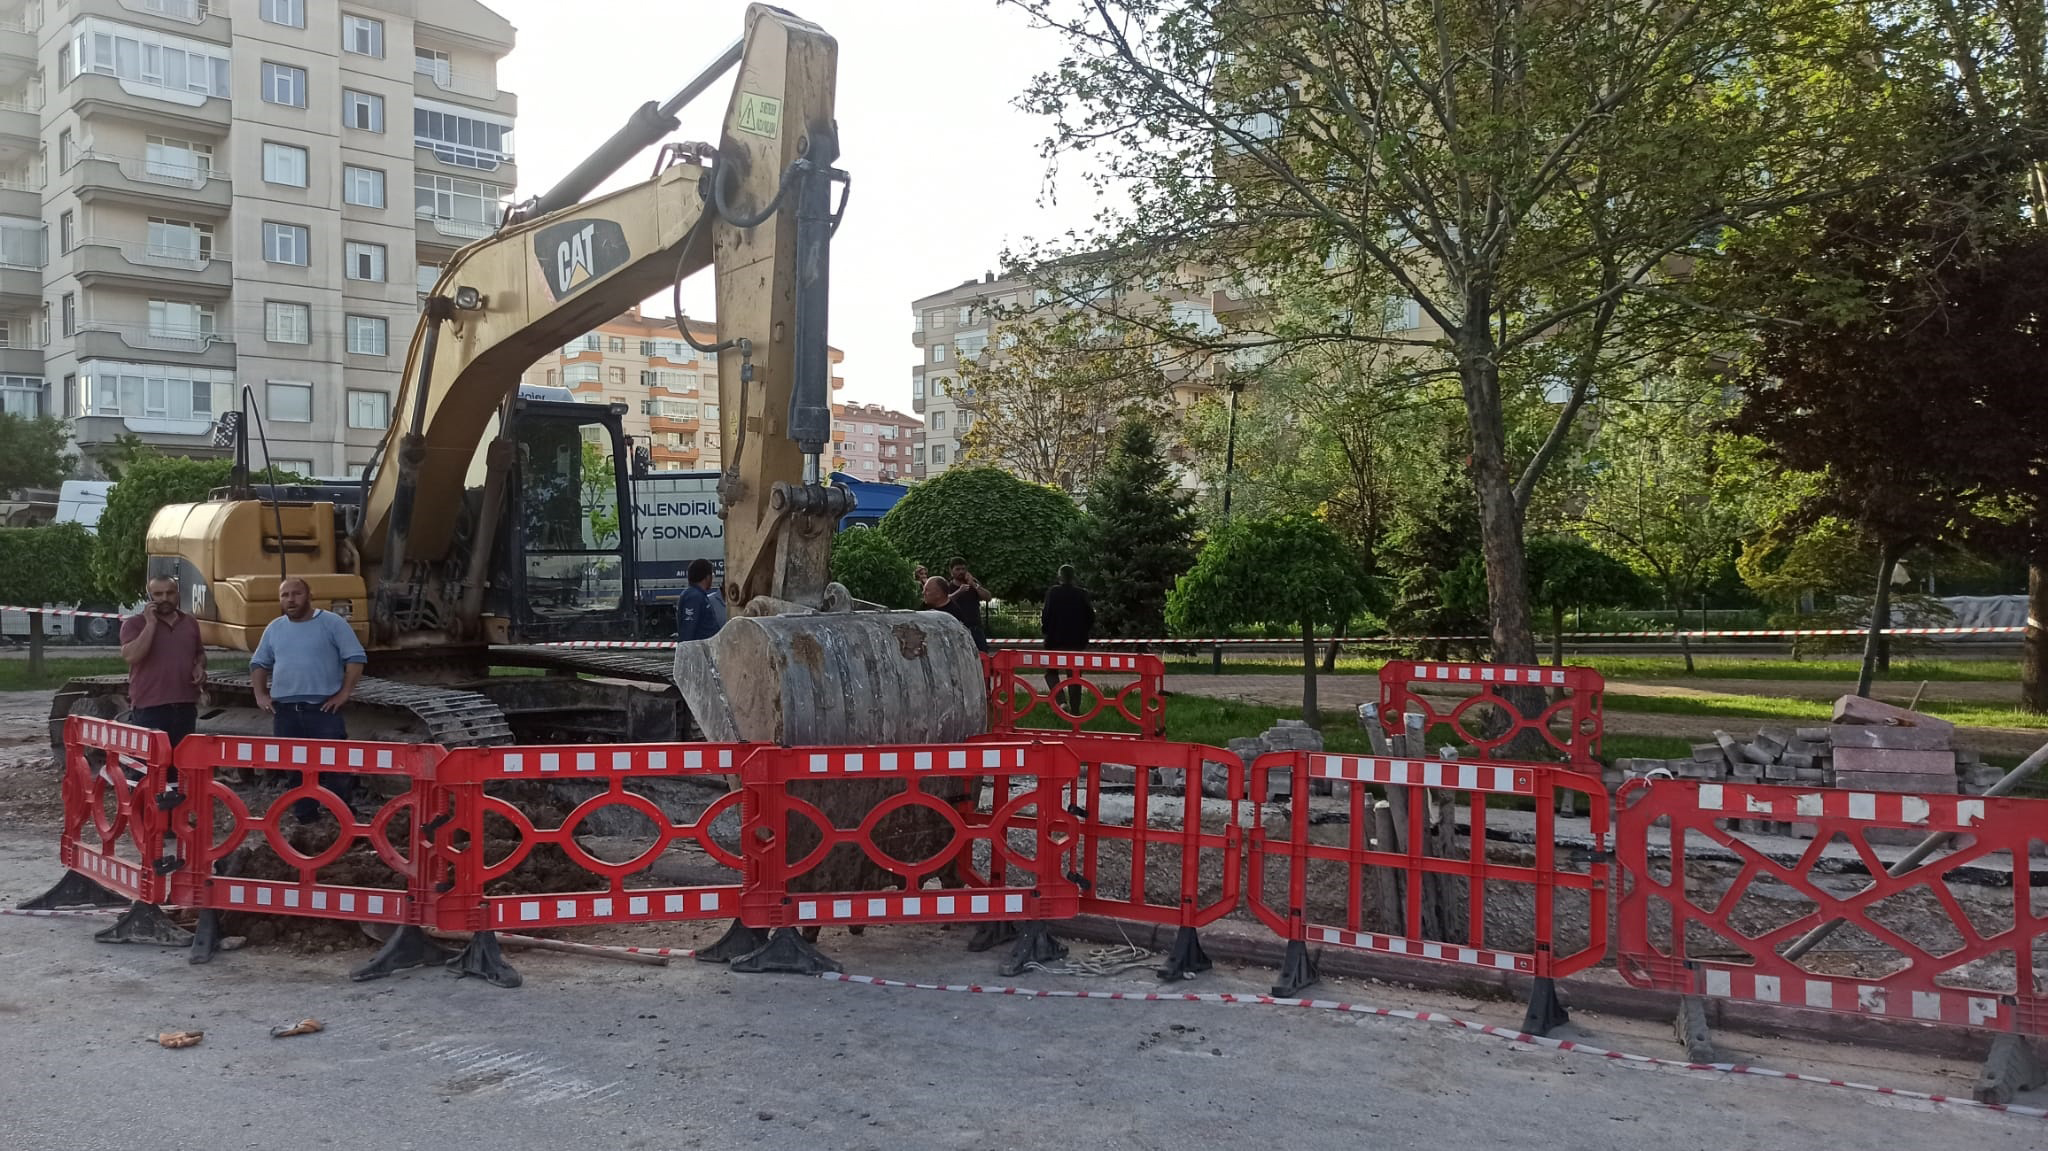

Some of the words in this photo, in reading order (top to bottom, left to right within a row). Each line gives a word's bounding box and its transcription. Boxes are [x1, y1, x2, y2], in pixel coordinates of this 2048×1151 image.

[557, 223, 595, 292] CAT
[652, 525, 723, 540] SONDAJ
[192, 584, 207, 615] CAT
